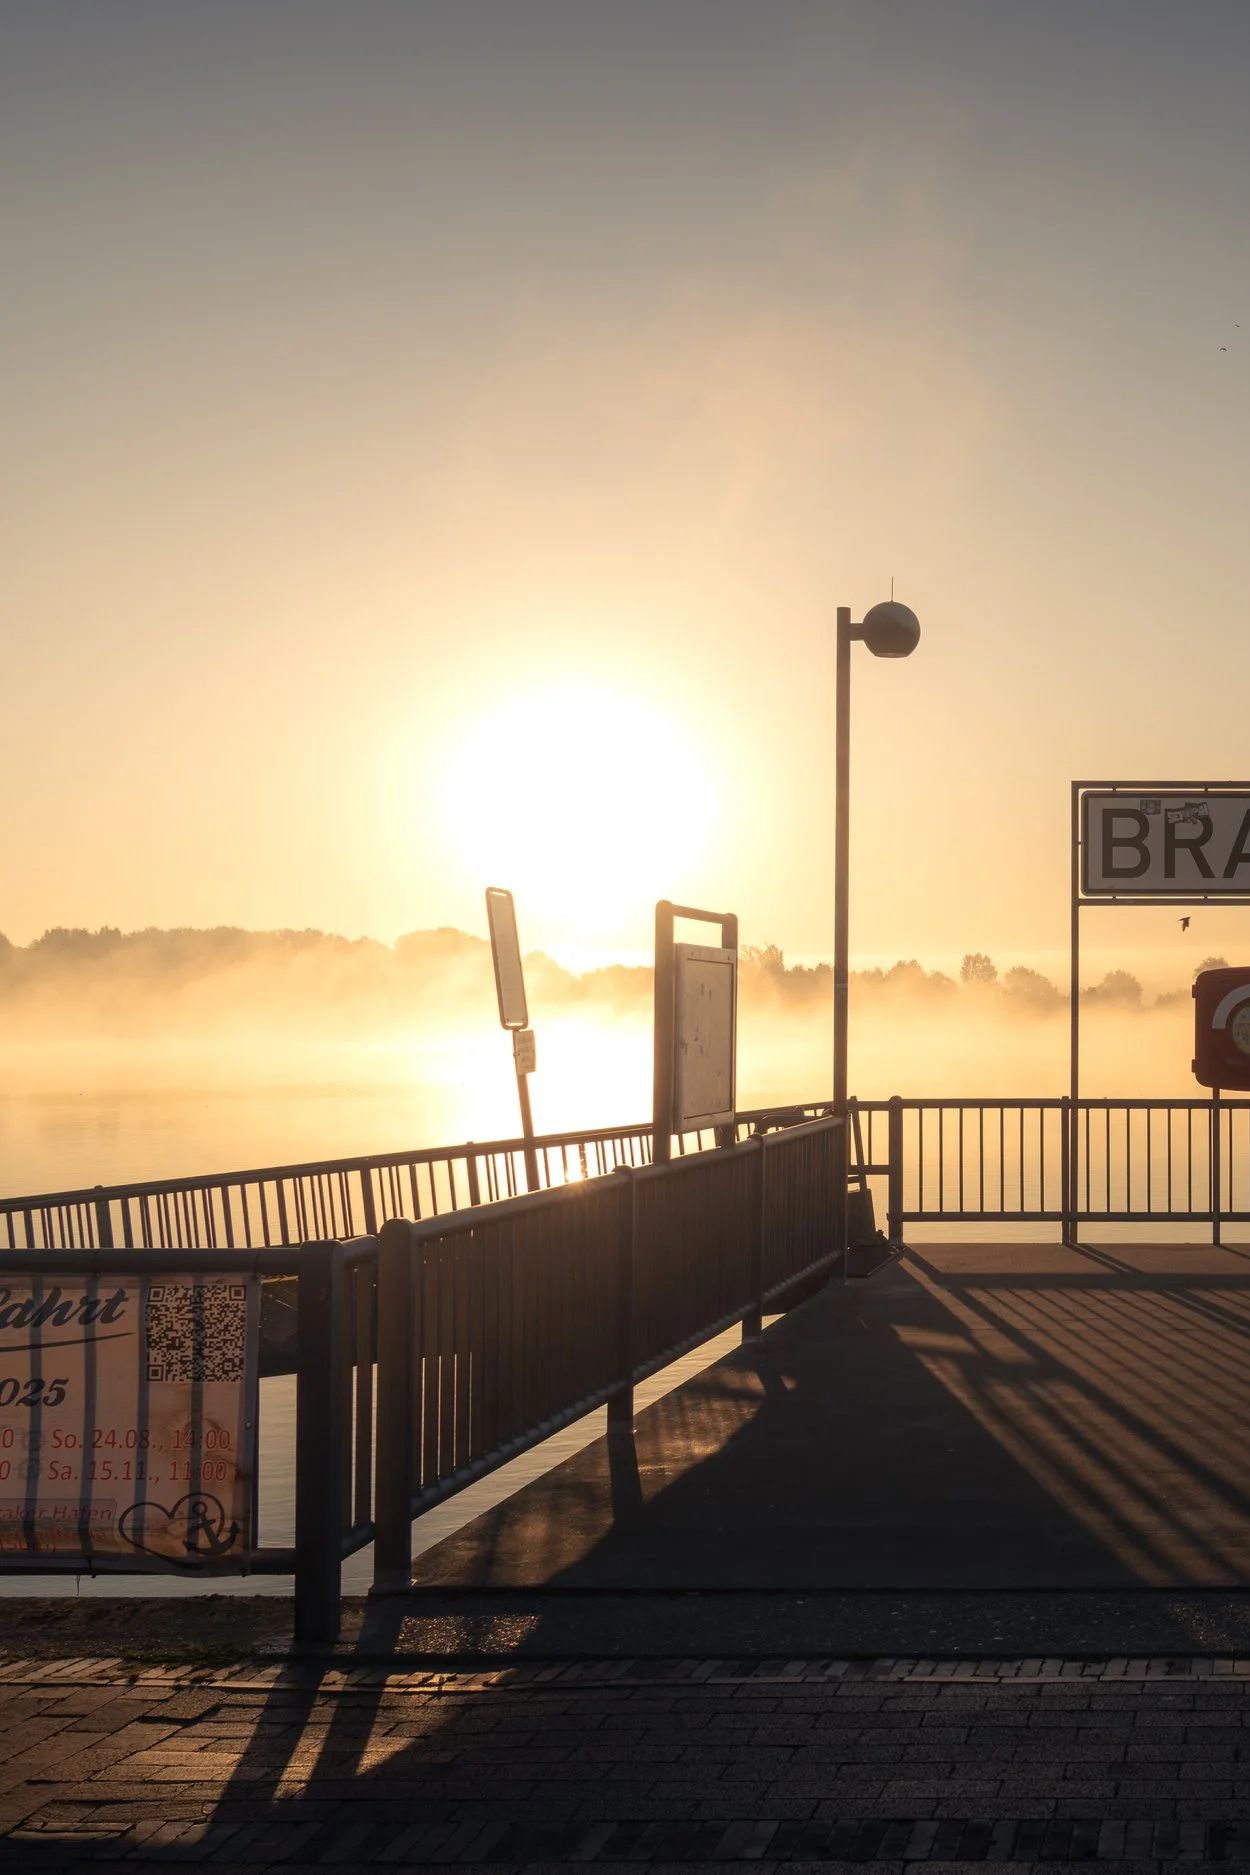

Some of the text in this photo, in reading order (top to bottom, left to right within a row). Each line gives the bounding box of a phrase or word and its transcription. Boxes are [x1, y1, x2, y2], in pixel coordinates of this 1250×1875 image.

[52, 1429, 83, 1449] So.
[92, 1429, 163, 1453] 24.08.,
[172, 1430, 231, 1450] 14:00
[48, 1460, 78, 1481] Sa.
[87, 1460, 160, 1484] 15.11.,
[169, 1461, 227, 1481] 11:00
[53, 1504, 112, 1520] Hafen
